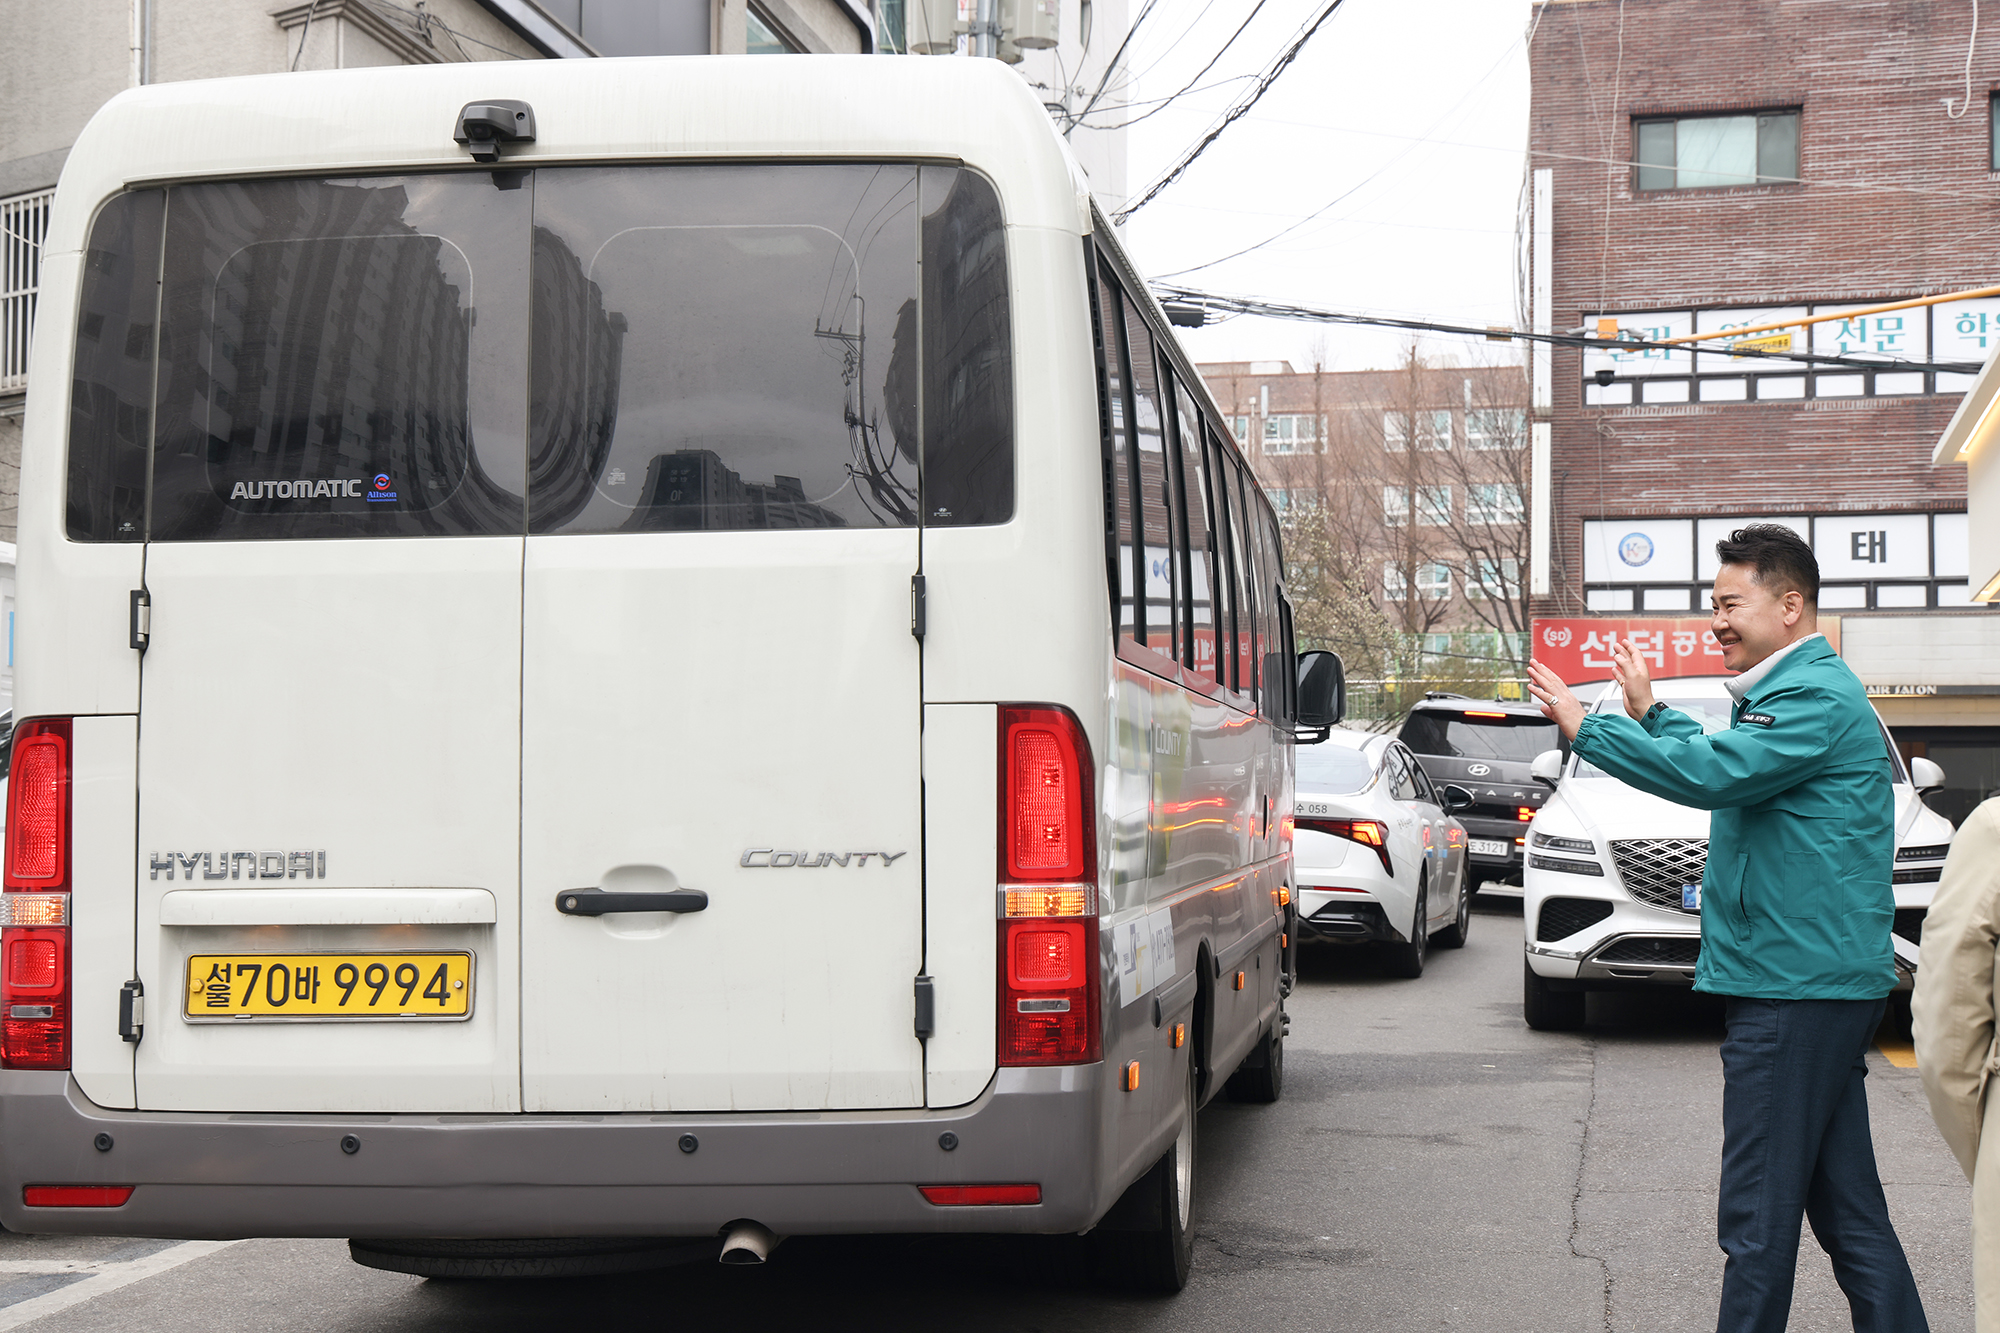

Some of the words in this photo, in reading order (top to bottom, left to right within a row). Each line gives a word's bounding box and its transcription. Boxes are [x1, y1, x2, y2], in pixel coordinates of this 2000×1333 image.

[1835, 317, 1906, 353] 전문
[230, 479, 362, 500] AUTOMATIC
[366, 490, 398, 498] Allison
[1851, 530, 1887, 563] 태
[1550, 631, 1566, 641] SD
[1579, 631, 1665, 668] 선덕
[1308, 804, 1328, 814] 058
[1478, 842, 1505, 854] 3121
[149, 849, 327, 881] HYUNDAI
[334, 962, 452, 1007] 9994
